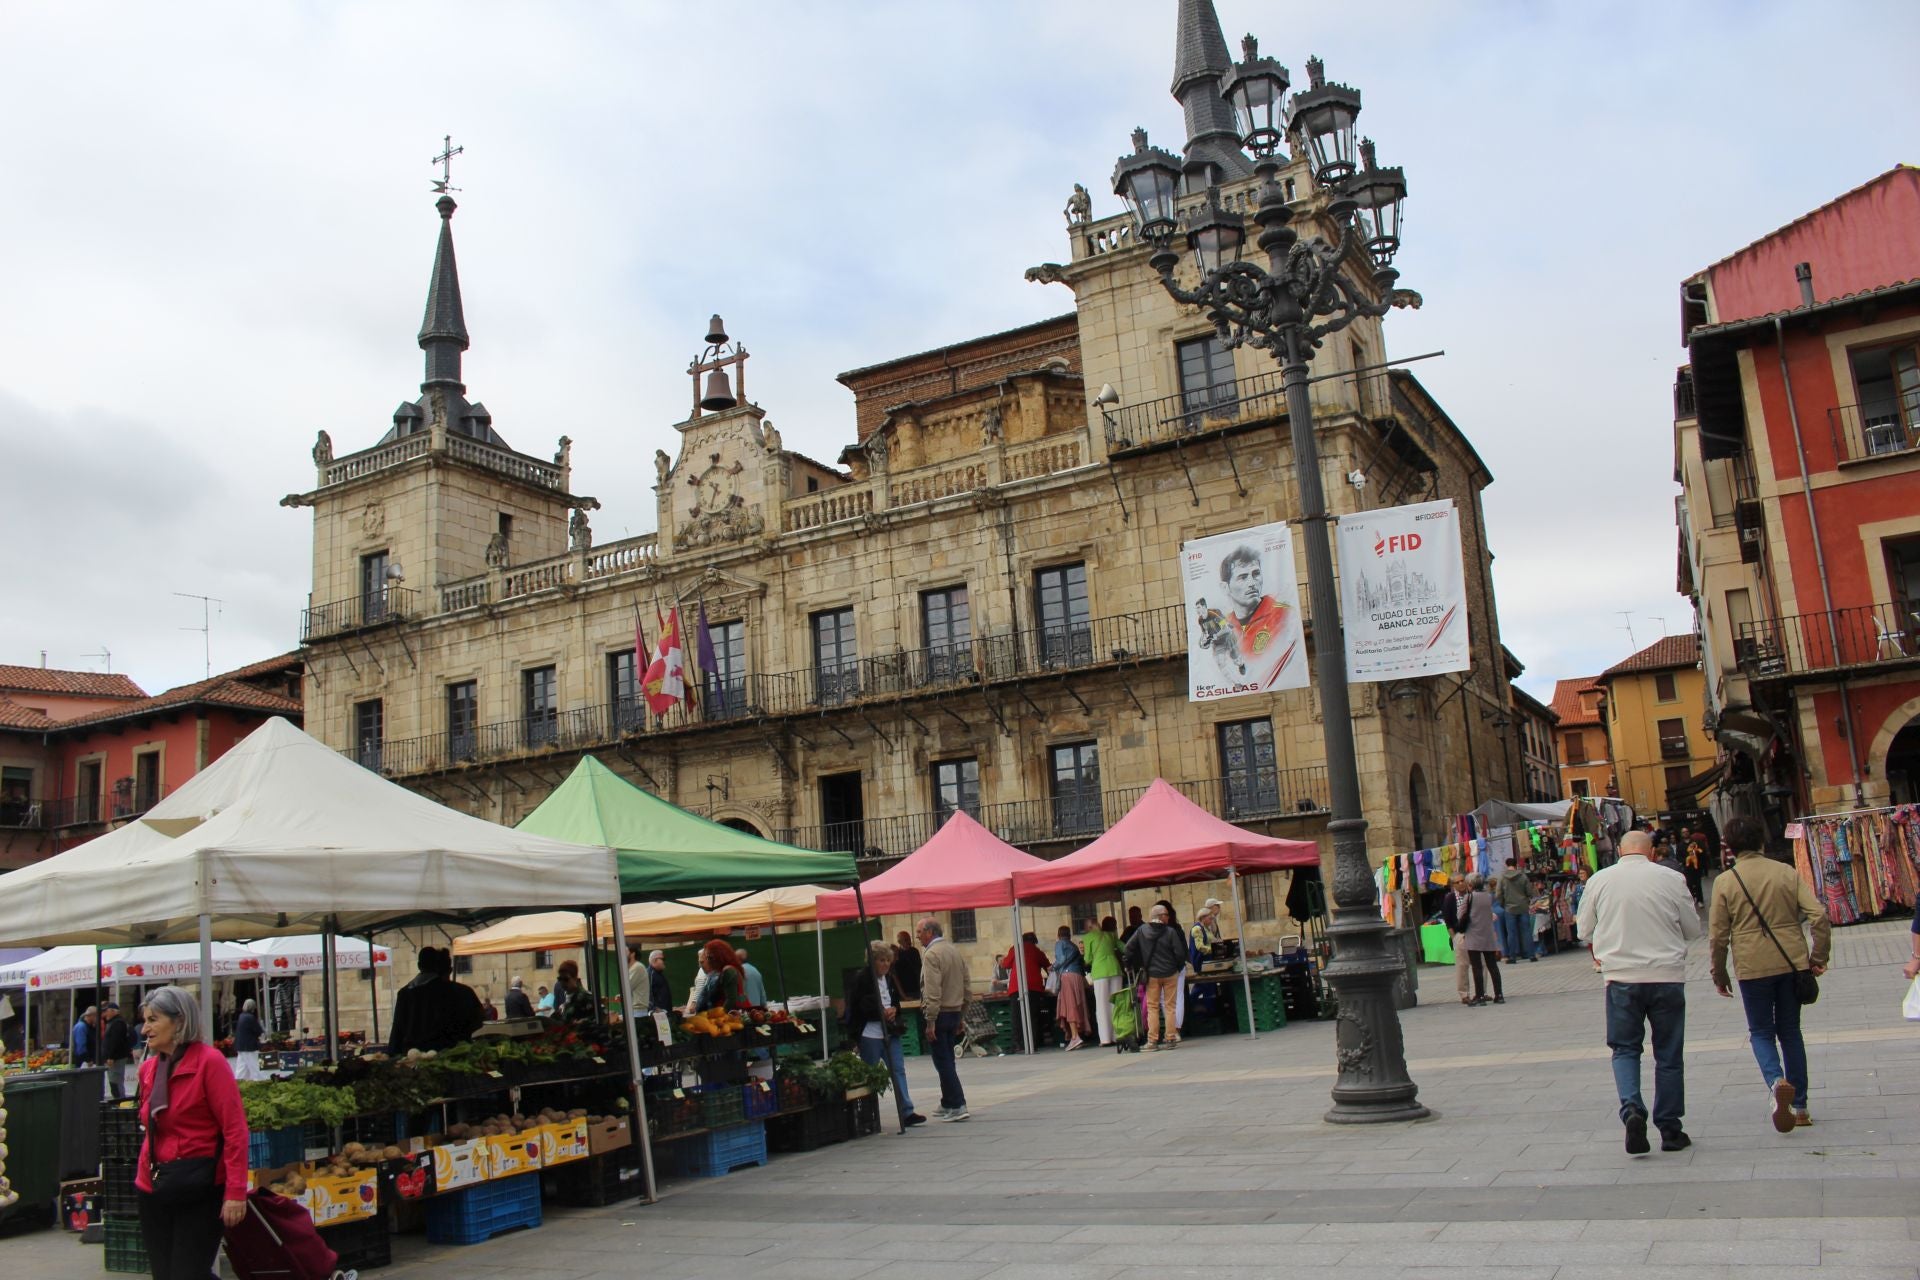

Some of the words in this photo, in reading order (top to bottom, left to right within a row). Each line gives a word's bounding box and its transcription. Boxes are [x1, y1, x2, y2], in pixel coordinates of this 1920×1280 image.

[1415, 511, 1448, 521] #FID2025
[1389, 533, 1422, 553] FID
[1371, 609, 1403, 621] CIUDAD
[1405, 607, 1418, 616] DE
[1420, 604, 1444, 615] LEÓN
[1378, 619, 1414, 630] ABANCA
[1416, 616, 1440, 625] 2025
[1196, 683, 1259, 698] CASILLAS
[295, 955, 315, 967] UÑA
[316, 954, 347, 966] PTO
[152, 961, 176, 976] UÑA
[178, 961, 212, 974] PRIE
[215, 961, 233, 972] S.C.
[44, 971, 59, 985] UÑA
[59, 969, 81, 982] PRIETO
